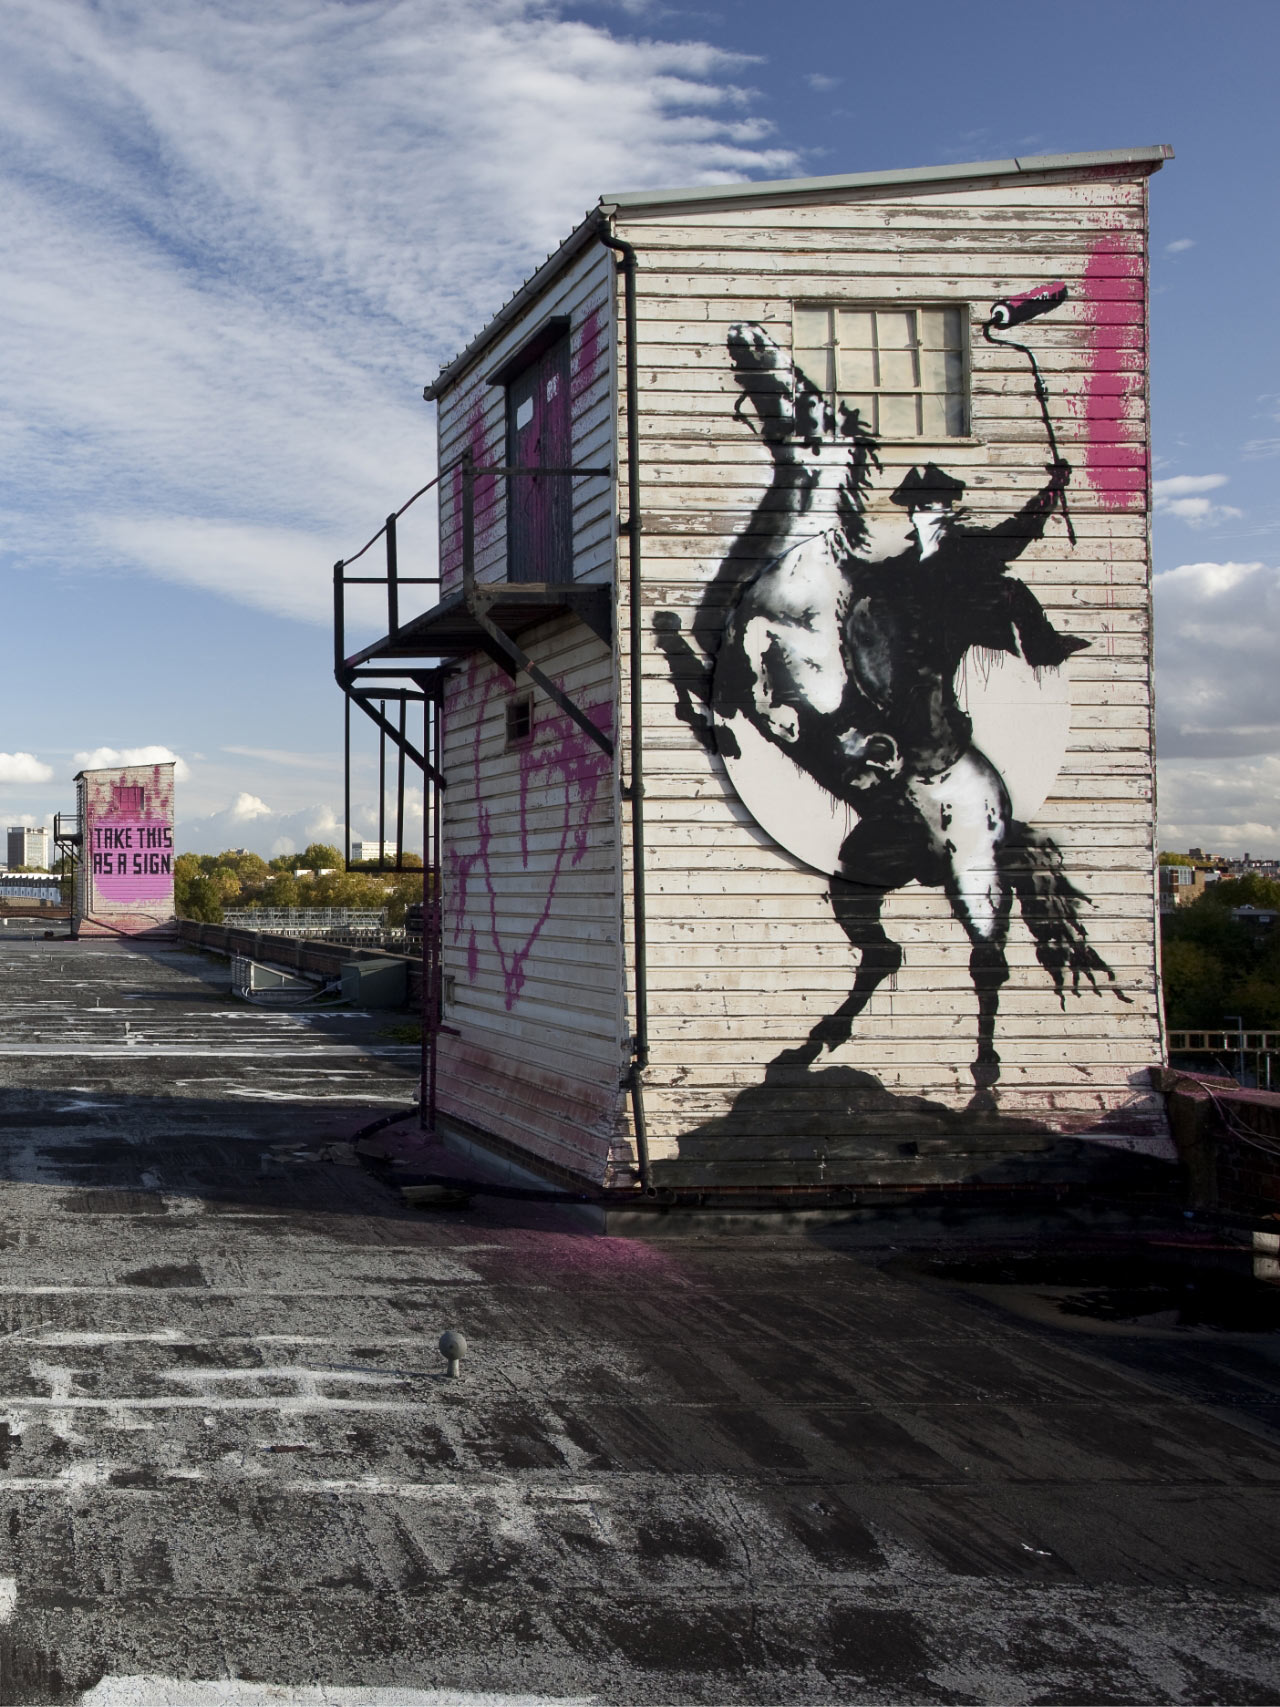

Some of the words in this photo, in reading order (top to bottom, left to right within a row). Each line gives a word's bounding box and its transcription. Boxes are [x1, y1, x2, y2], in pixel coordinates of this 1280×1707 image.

[94, 827, 132, 849] TAKE
[137, 827, 172, 849] THIS
[93, 852, 113, 875] AS
[118, 853, 127, 875] A
[133, 853, 170, 875] SIGN
